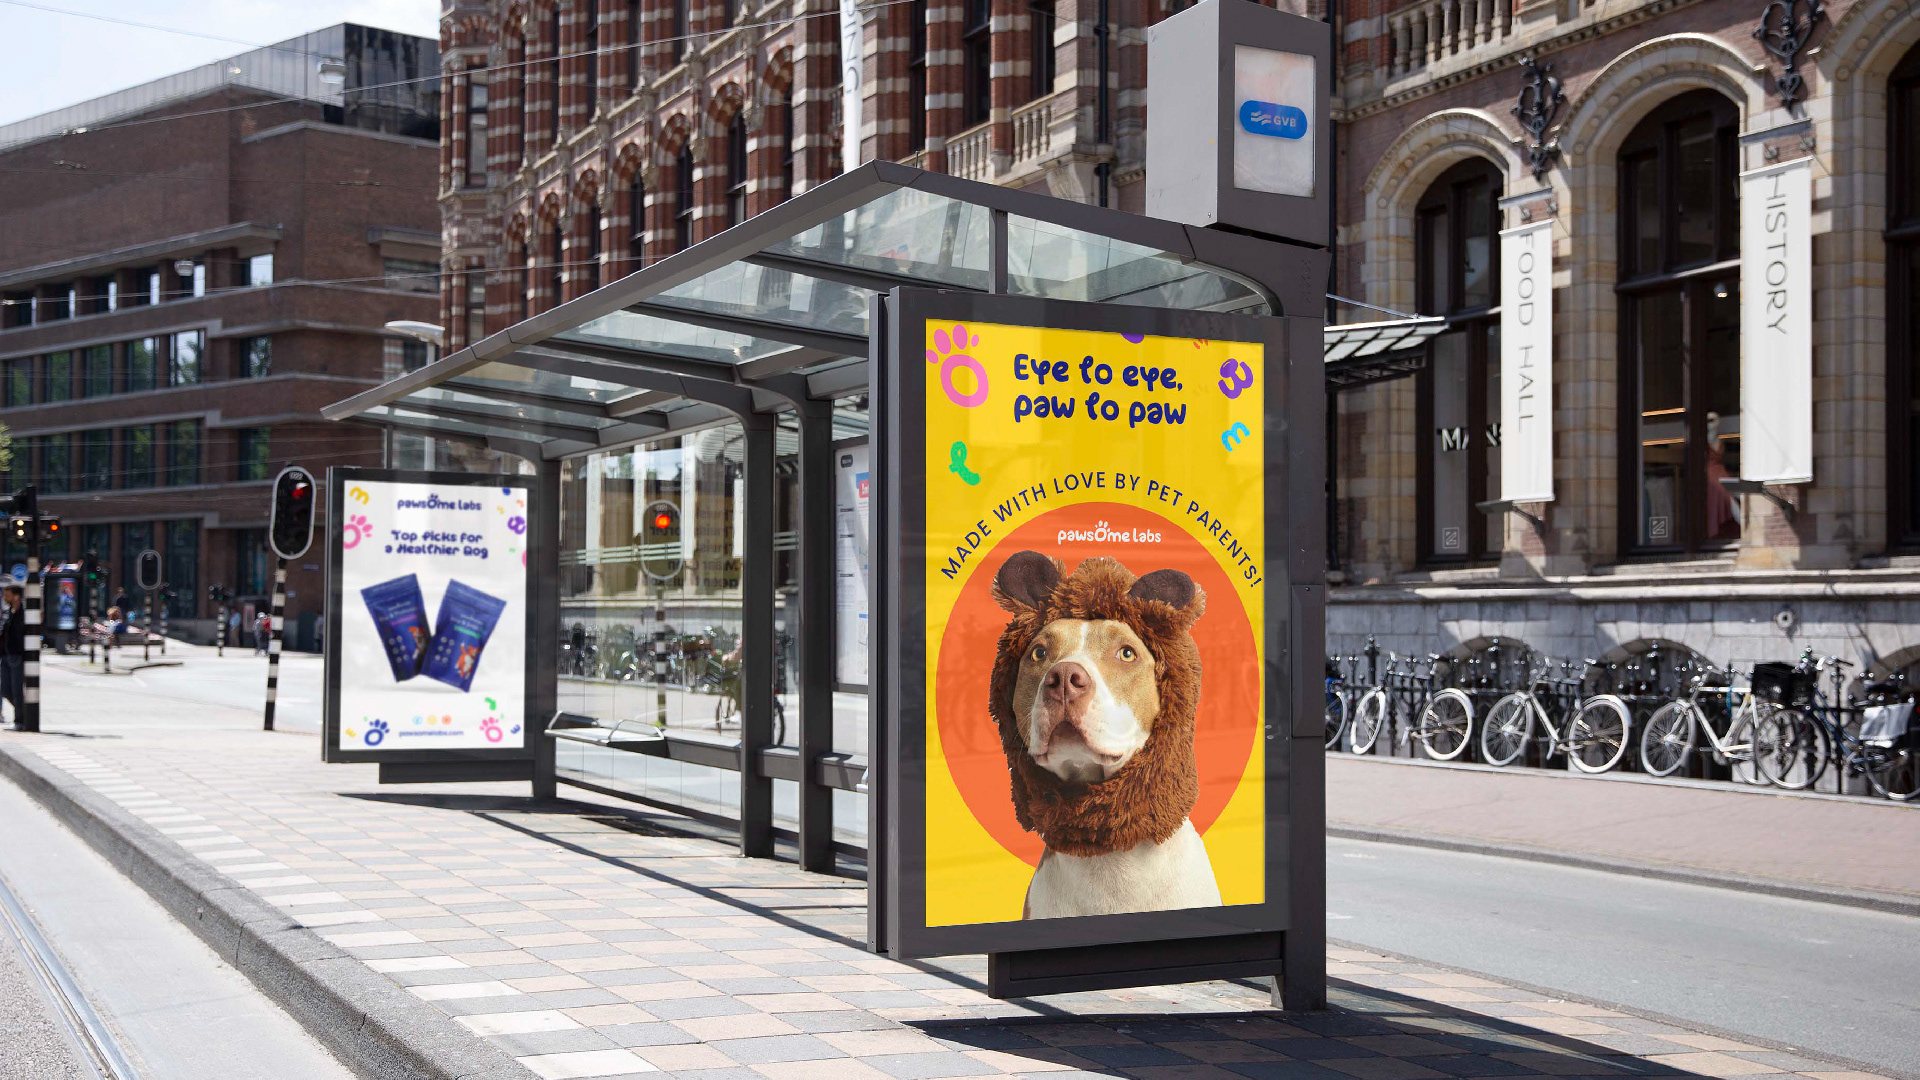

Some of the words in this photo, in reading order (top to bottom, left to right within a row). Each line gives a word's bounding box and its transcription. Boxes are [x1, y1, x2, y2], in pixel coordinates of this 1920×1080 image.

[1273, 115, 1297, 128] GVB
[1765, 172, 1789, 335] HISTORY
[1518, 233, 1535, 327] FOOD
[1013, 353, 1069, 385] Eye
[1078, 355, 1113, 384] to
[1122, 365, 1183, 392] eye,
[1518, 344, 1536, 433] HALL
[1013, 394, 1075, 423] paw
[1085, 391, 1120, 420] to
[1128, 401, 1187, 429] paw
[457, 499, 482, 511] labs
[390, 529, 418, 543] Top
[460, 532, 483, 543] for
[941, 520, 992, 580] MADE
[993, 483, 1047, 522] WITH
[1053, 471, 1106, 495] LOVE
[1115, 472, 1141, 491] BY
[1147, 480, 1183, 507] PET
[1186, 500, 1263, 588] PARENTS!
[1132, 527, 1162, 543] labs
[384, 544, 393, 554] a
[396, 543, 460, 555] Healthier
